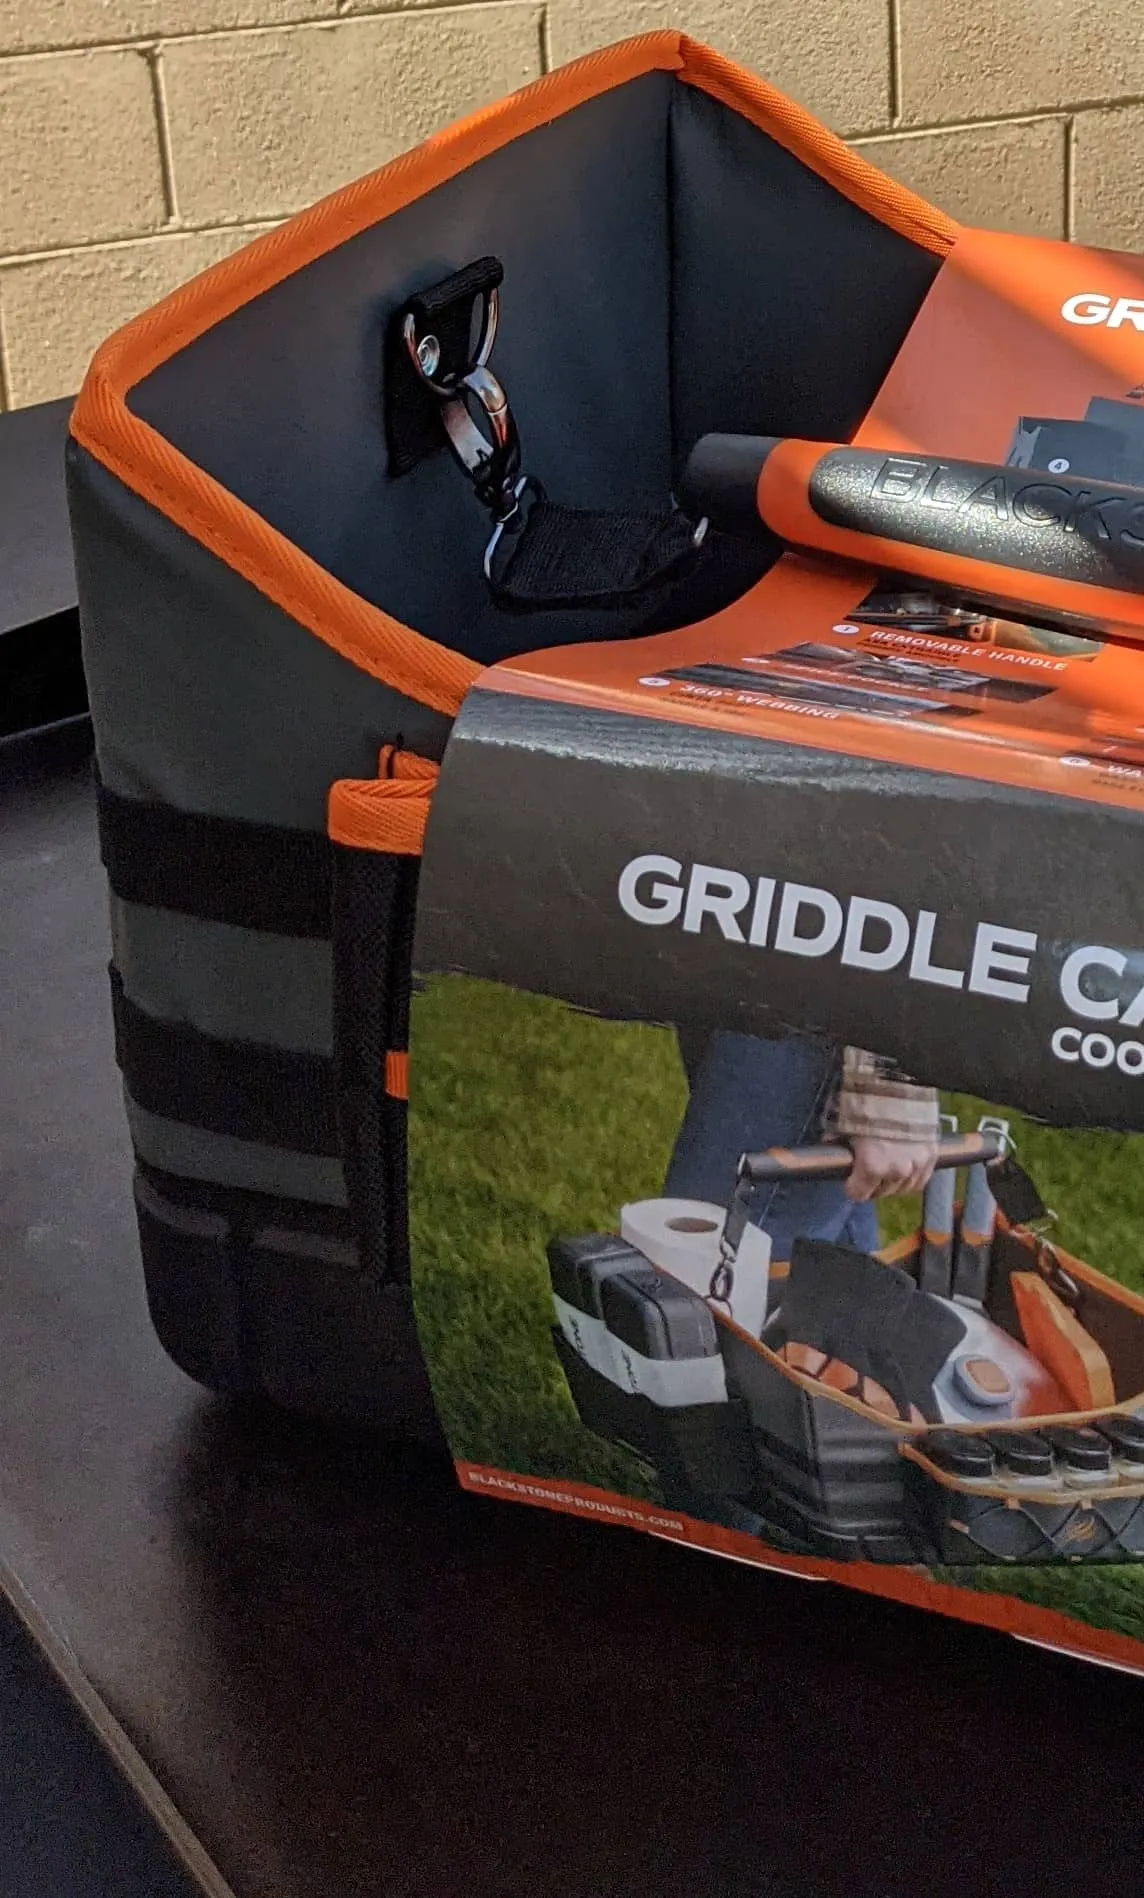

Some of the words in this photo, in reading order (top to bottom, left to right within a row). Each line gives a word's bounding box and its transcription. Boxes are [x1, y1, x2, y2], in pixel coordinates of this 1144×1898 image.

[871, 631, 986, 657] REMOVABLE
[988, 651, 1068, 671] HANDLE
[736, 694, 840, 720] WEBBING
[619, 854, 1037, 1002] GRIDDLE
